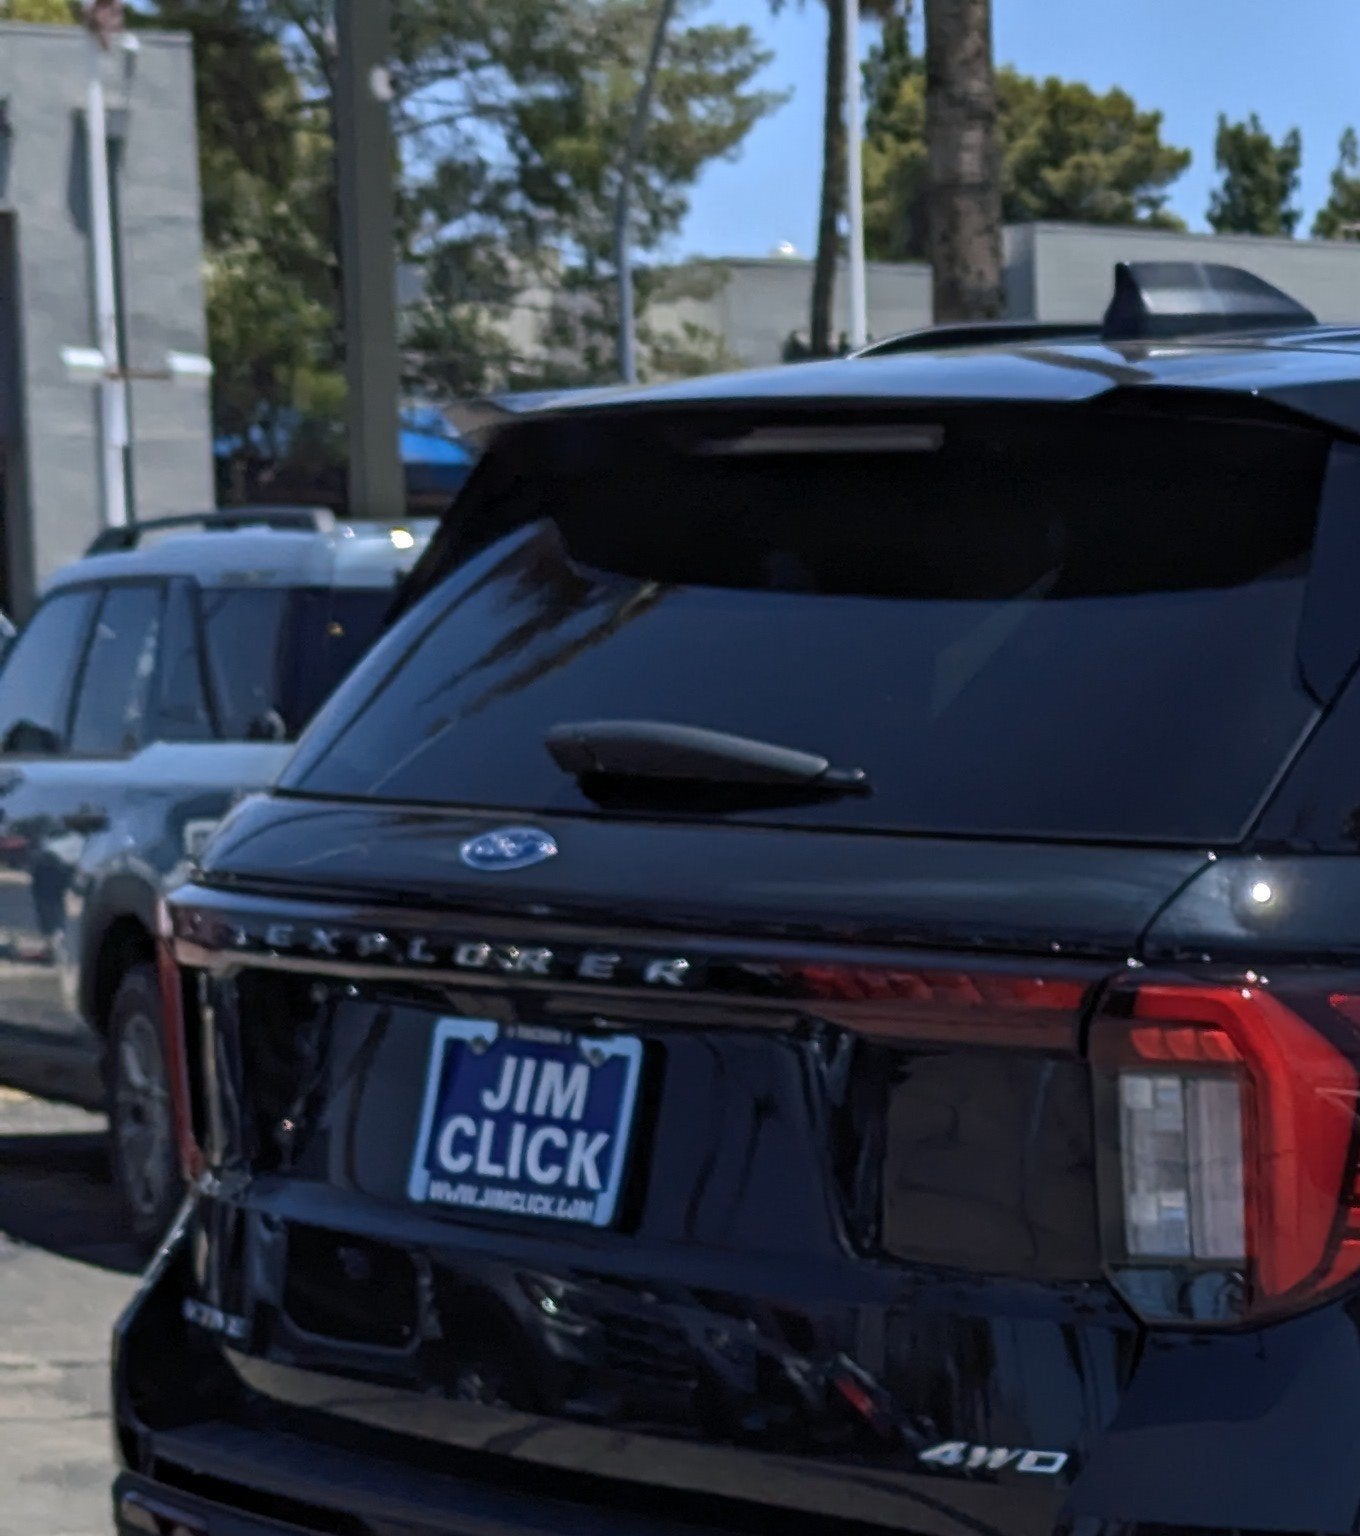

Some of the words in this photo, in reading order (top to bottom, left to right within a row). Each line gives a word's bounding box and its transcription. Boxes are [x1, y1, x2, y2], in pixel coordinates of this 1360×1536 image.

[265, 923, 691, 987] EXPLORER
[482, 1054, 590, 1121] JIM
[438, 1114, 610, 1190] CLICK
[918, 1440, 1069, 1475] 4WD
